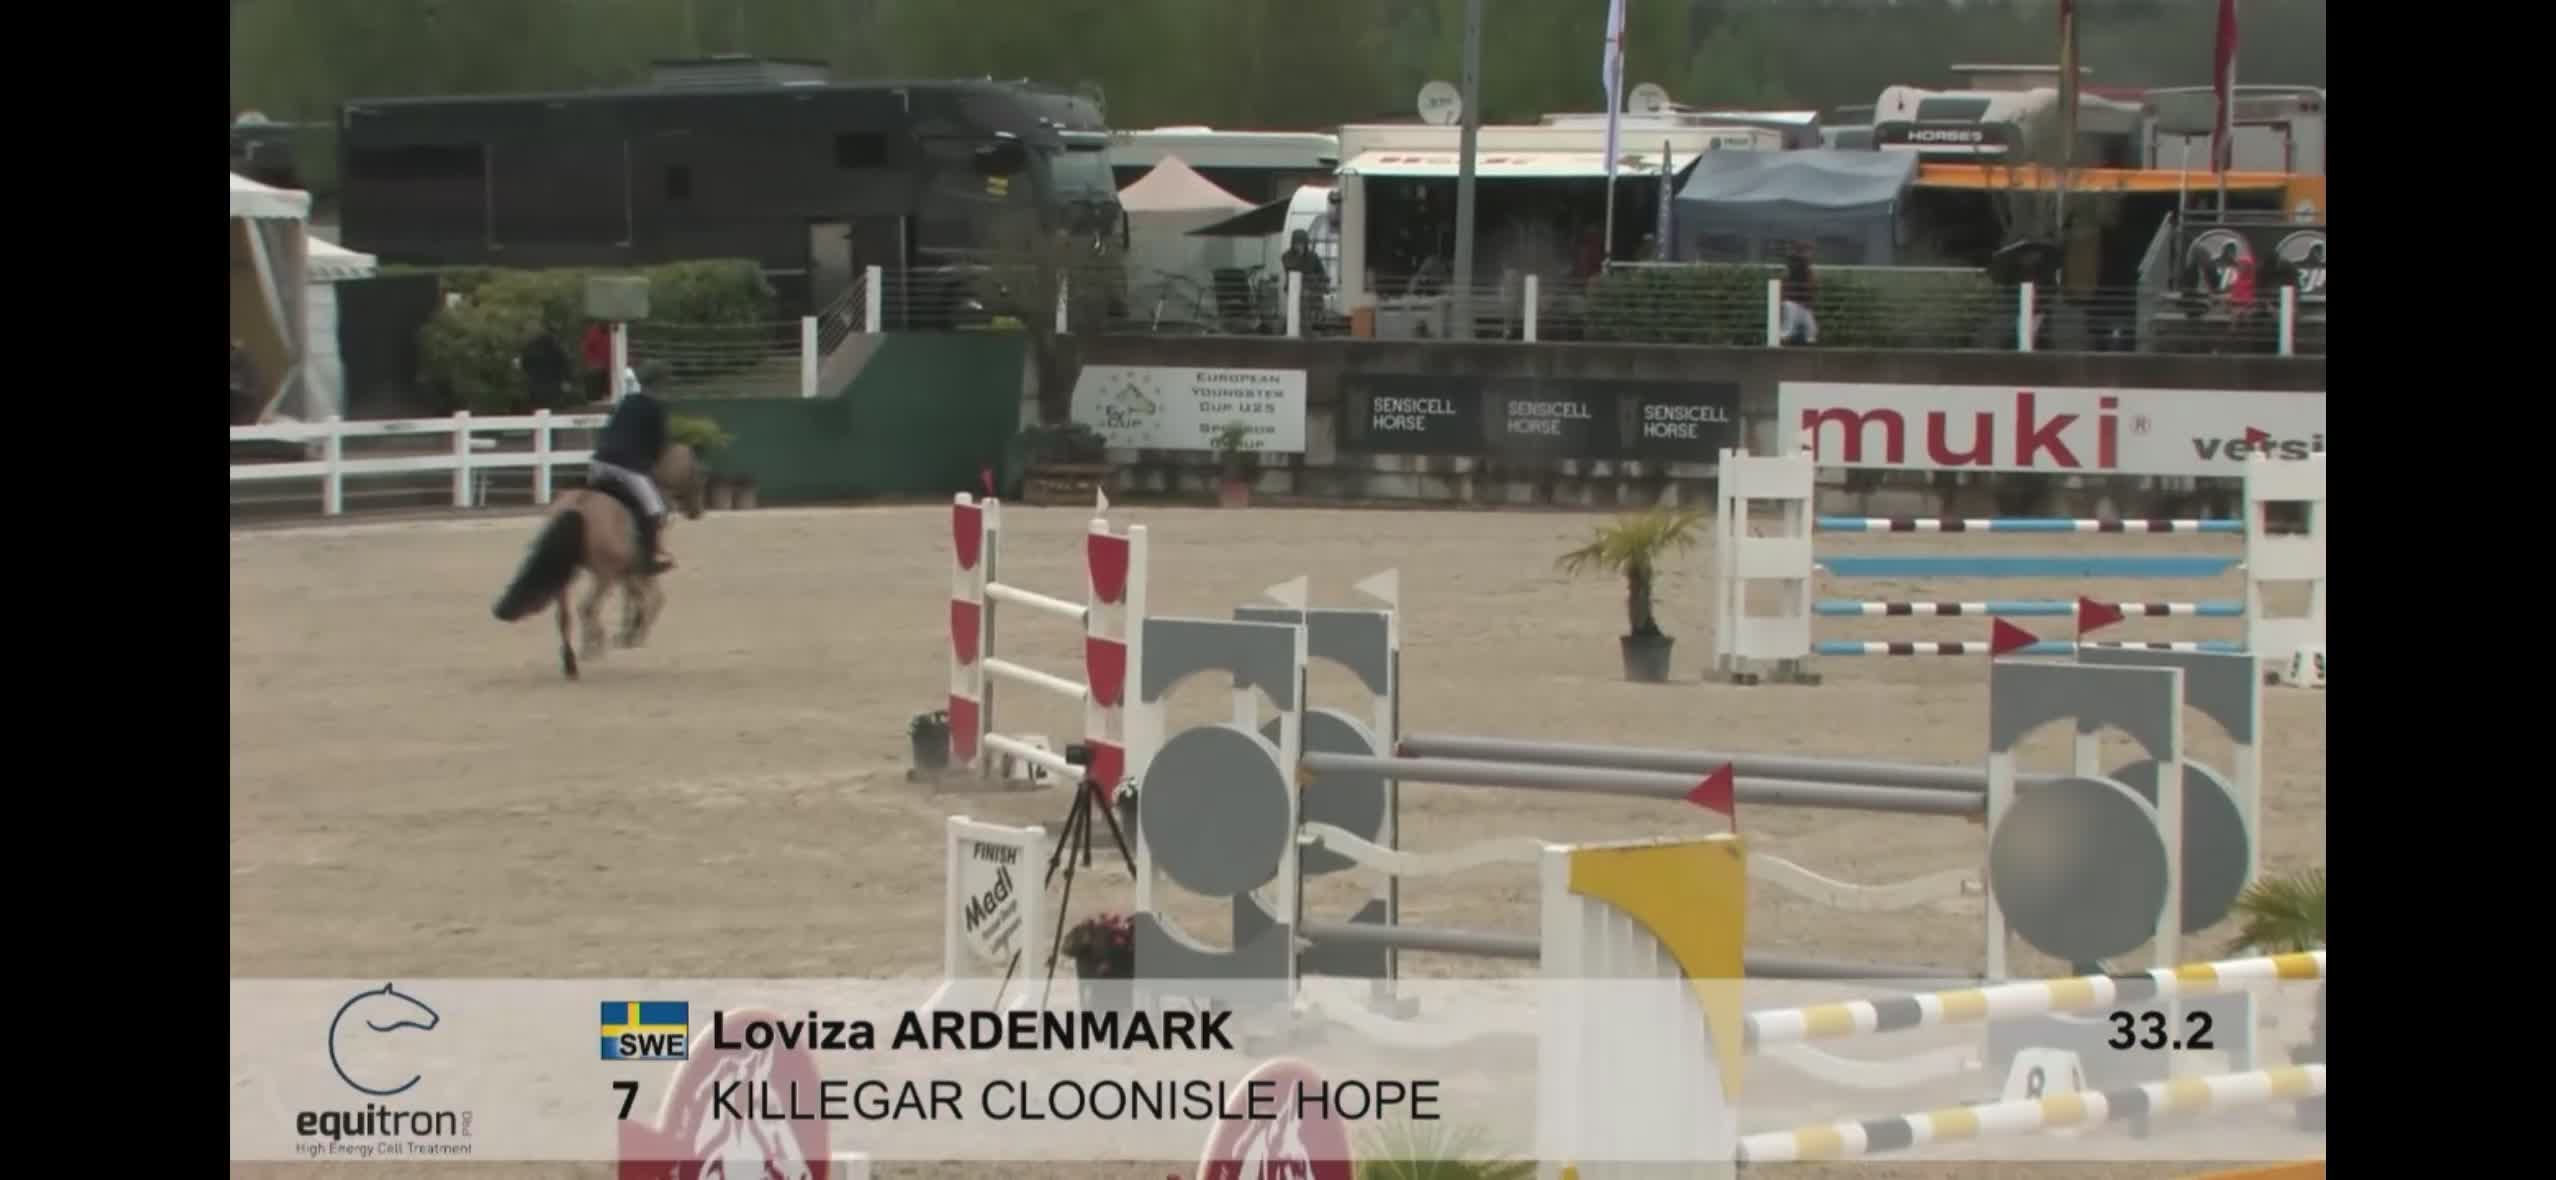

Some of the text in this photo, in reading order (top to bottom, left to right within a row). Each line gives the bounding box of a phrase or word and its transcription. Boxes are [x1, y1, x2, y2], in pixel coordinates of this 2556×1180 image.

[1373, 398, 1456, 415] SENSICELL
[1507, 401, 1592, 420] SENSICELL
[1643, 404, 1729, 424] SENSICELL
[1373, 414, 1425, 432] HORSE
[1507, 418, 1561, 436] HORSE
[1643, 422, 1697, 439] HORSE
[1802, 391, 2119, 469] muki
[973, 841, 1017, 865] FINISH
